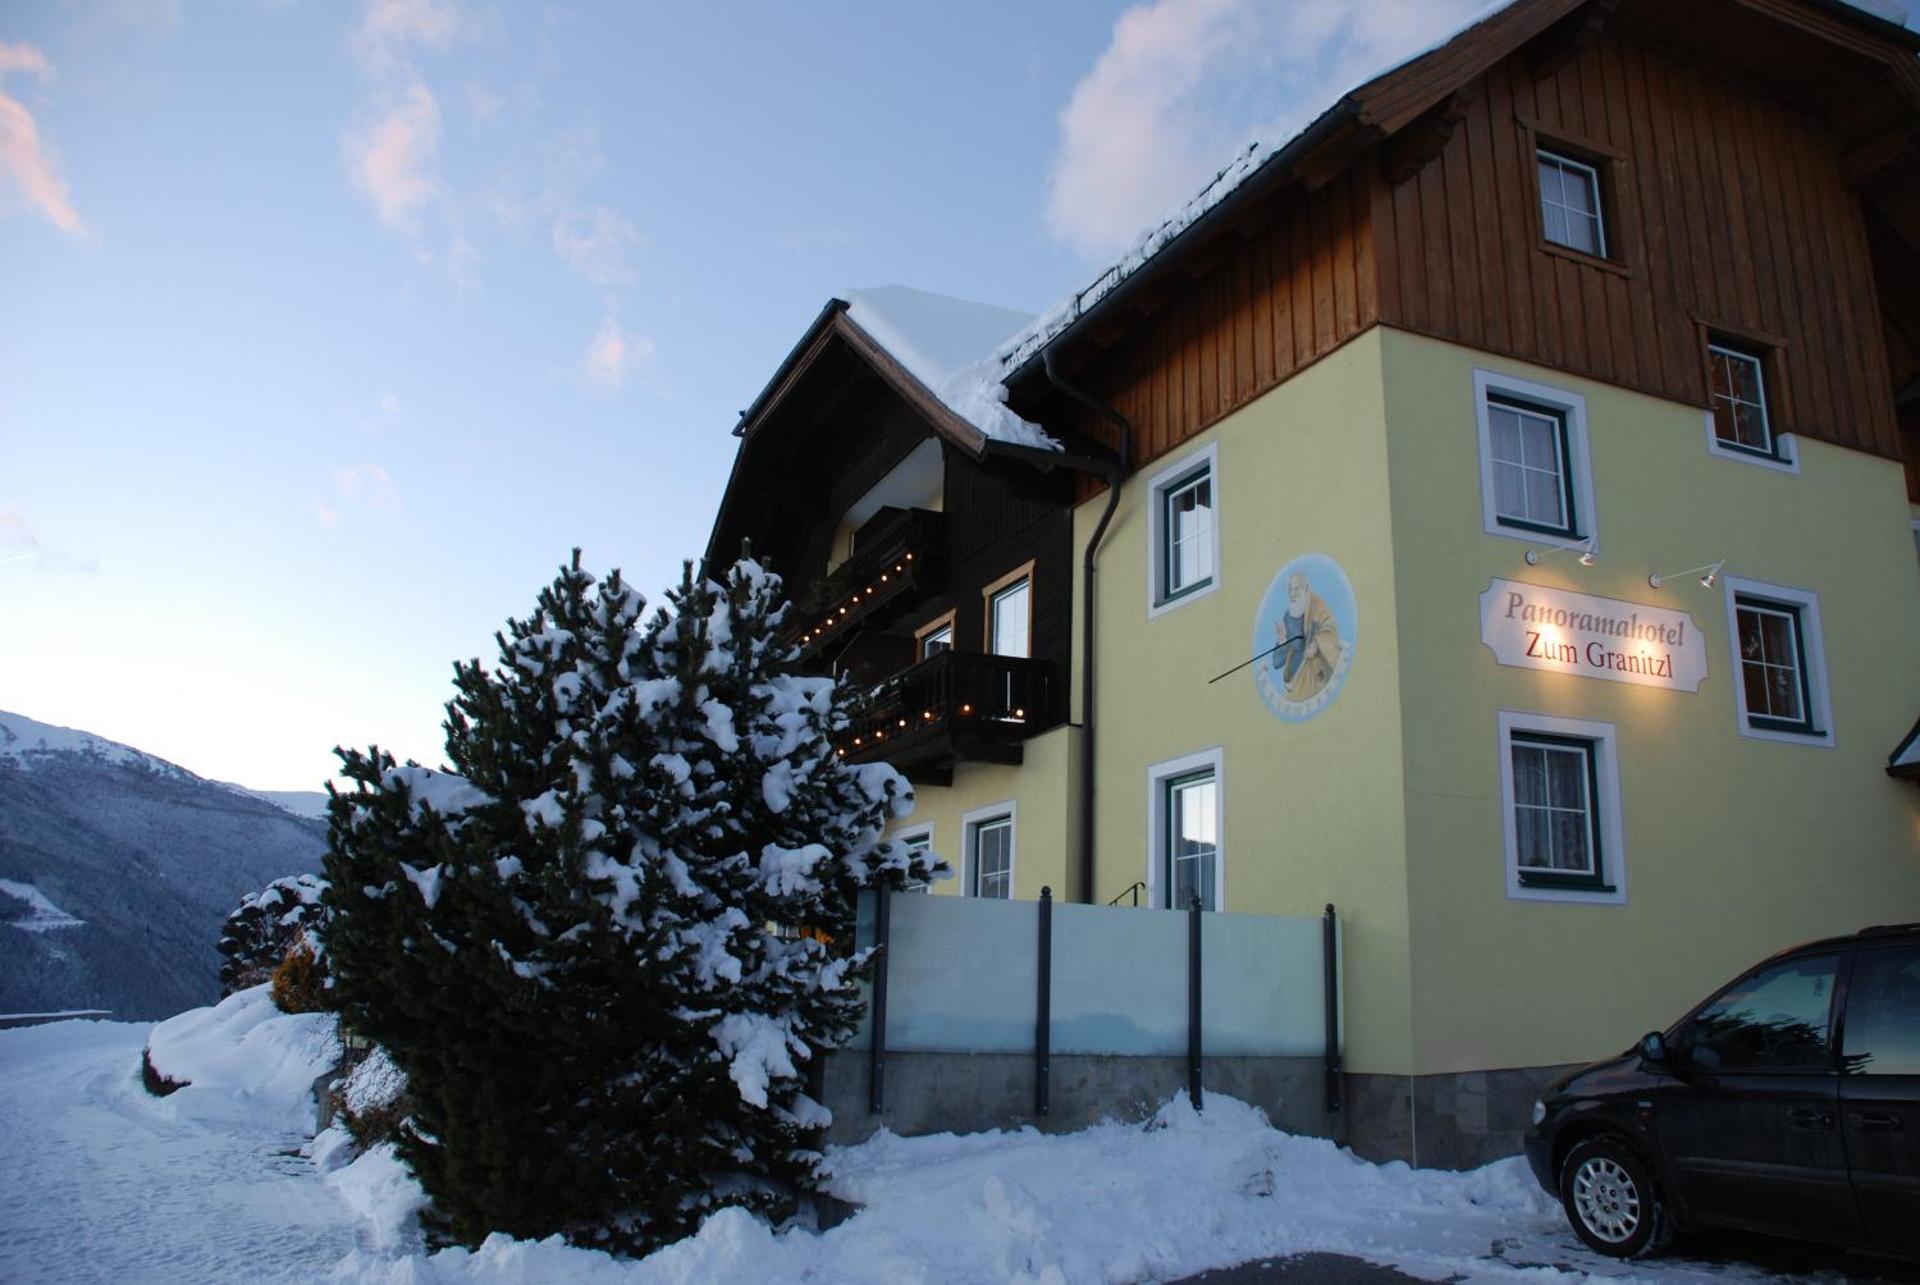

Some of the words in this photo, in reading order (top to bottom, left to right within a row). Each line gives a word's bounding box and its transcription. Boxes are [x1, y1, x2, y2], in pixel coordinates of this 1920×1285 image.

[1505, 591, 1684, 646] Panoramahotel
[1525, 631, 1578, 664] Zum
[1586, 641, 1673, 679] Granitzl
